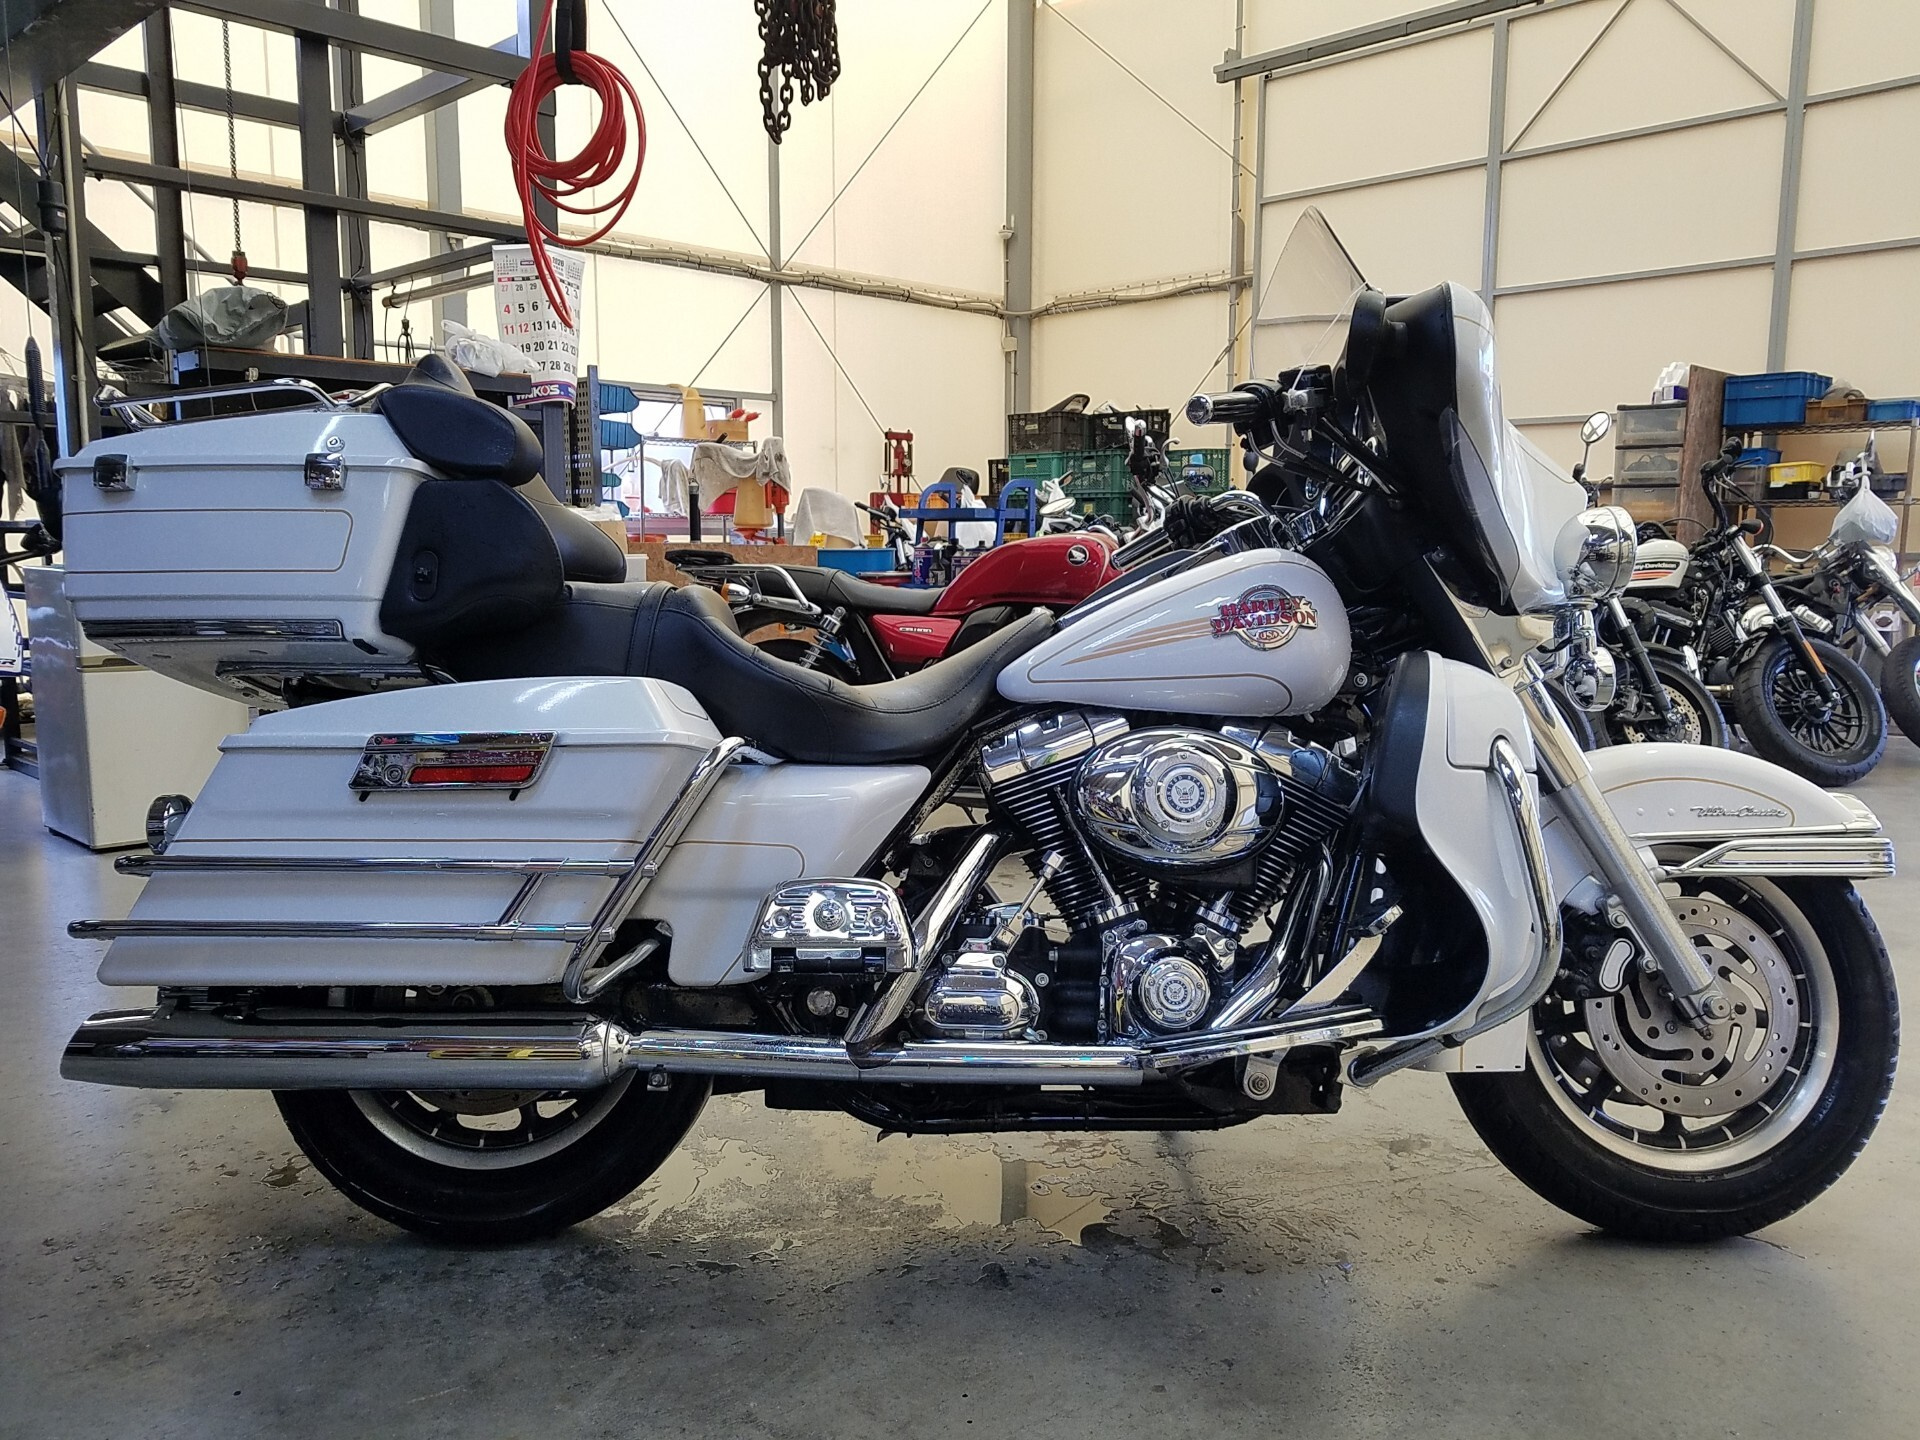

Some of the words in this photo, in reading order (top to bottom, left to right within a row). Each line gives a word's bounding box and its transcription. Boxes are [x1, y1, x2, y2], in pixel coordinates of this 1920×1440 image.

[501, 284, 509, 292] 27
[515, 284, 523, 292] 28
[564, 286, 570, 295] 2
[503, 304, 511, 314] 4
[518, 303, 525, 314] 5
[531, 301, 539, 311] 6
[545, 299, 552, 310] 7
[504, 325, 515, 335] 11
[518, 322, 529, 334] 12
[532, 320, 543, 332] 13
[546, 320, 557, 330] 14
[520, 342, 531, 353] 19
[533, 340, 545, 351] 20
[547, 339, 558, 350] 21
[561, 341, 569, 353] 22
[549, 360, 561, 370] 28
[1212, 610, 1318, 634] DAVIDSON
[1259, 629, 1280, 640] USA
